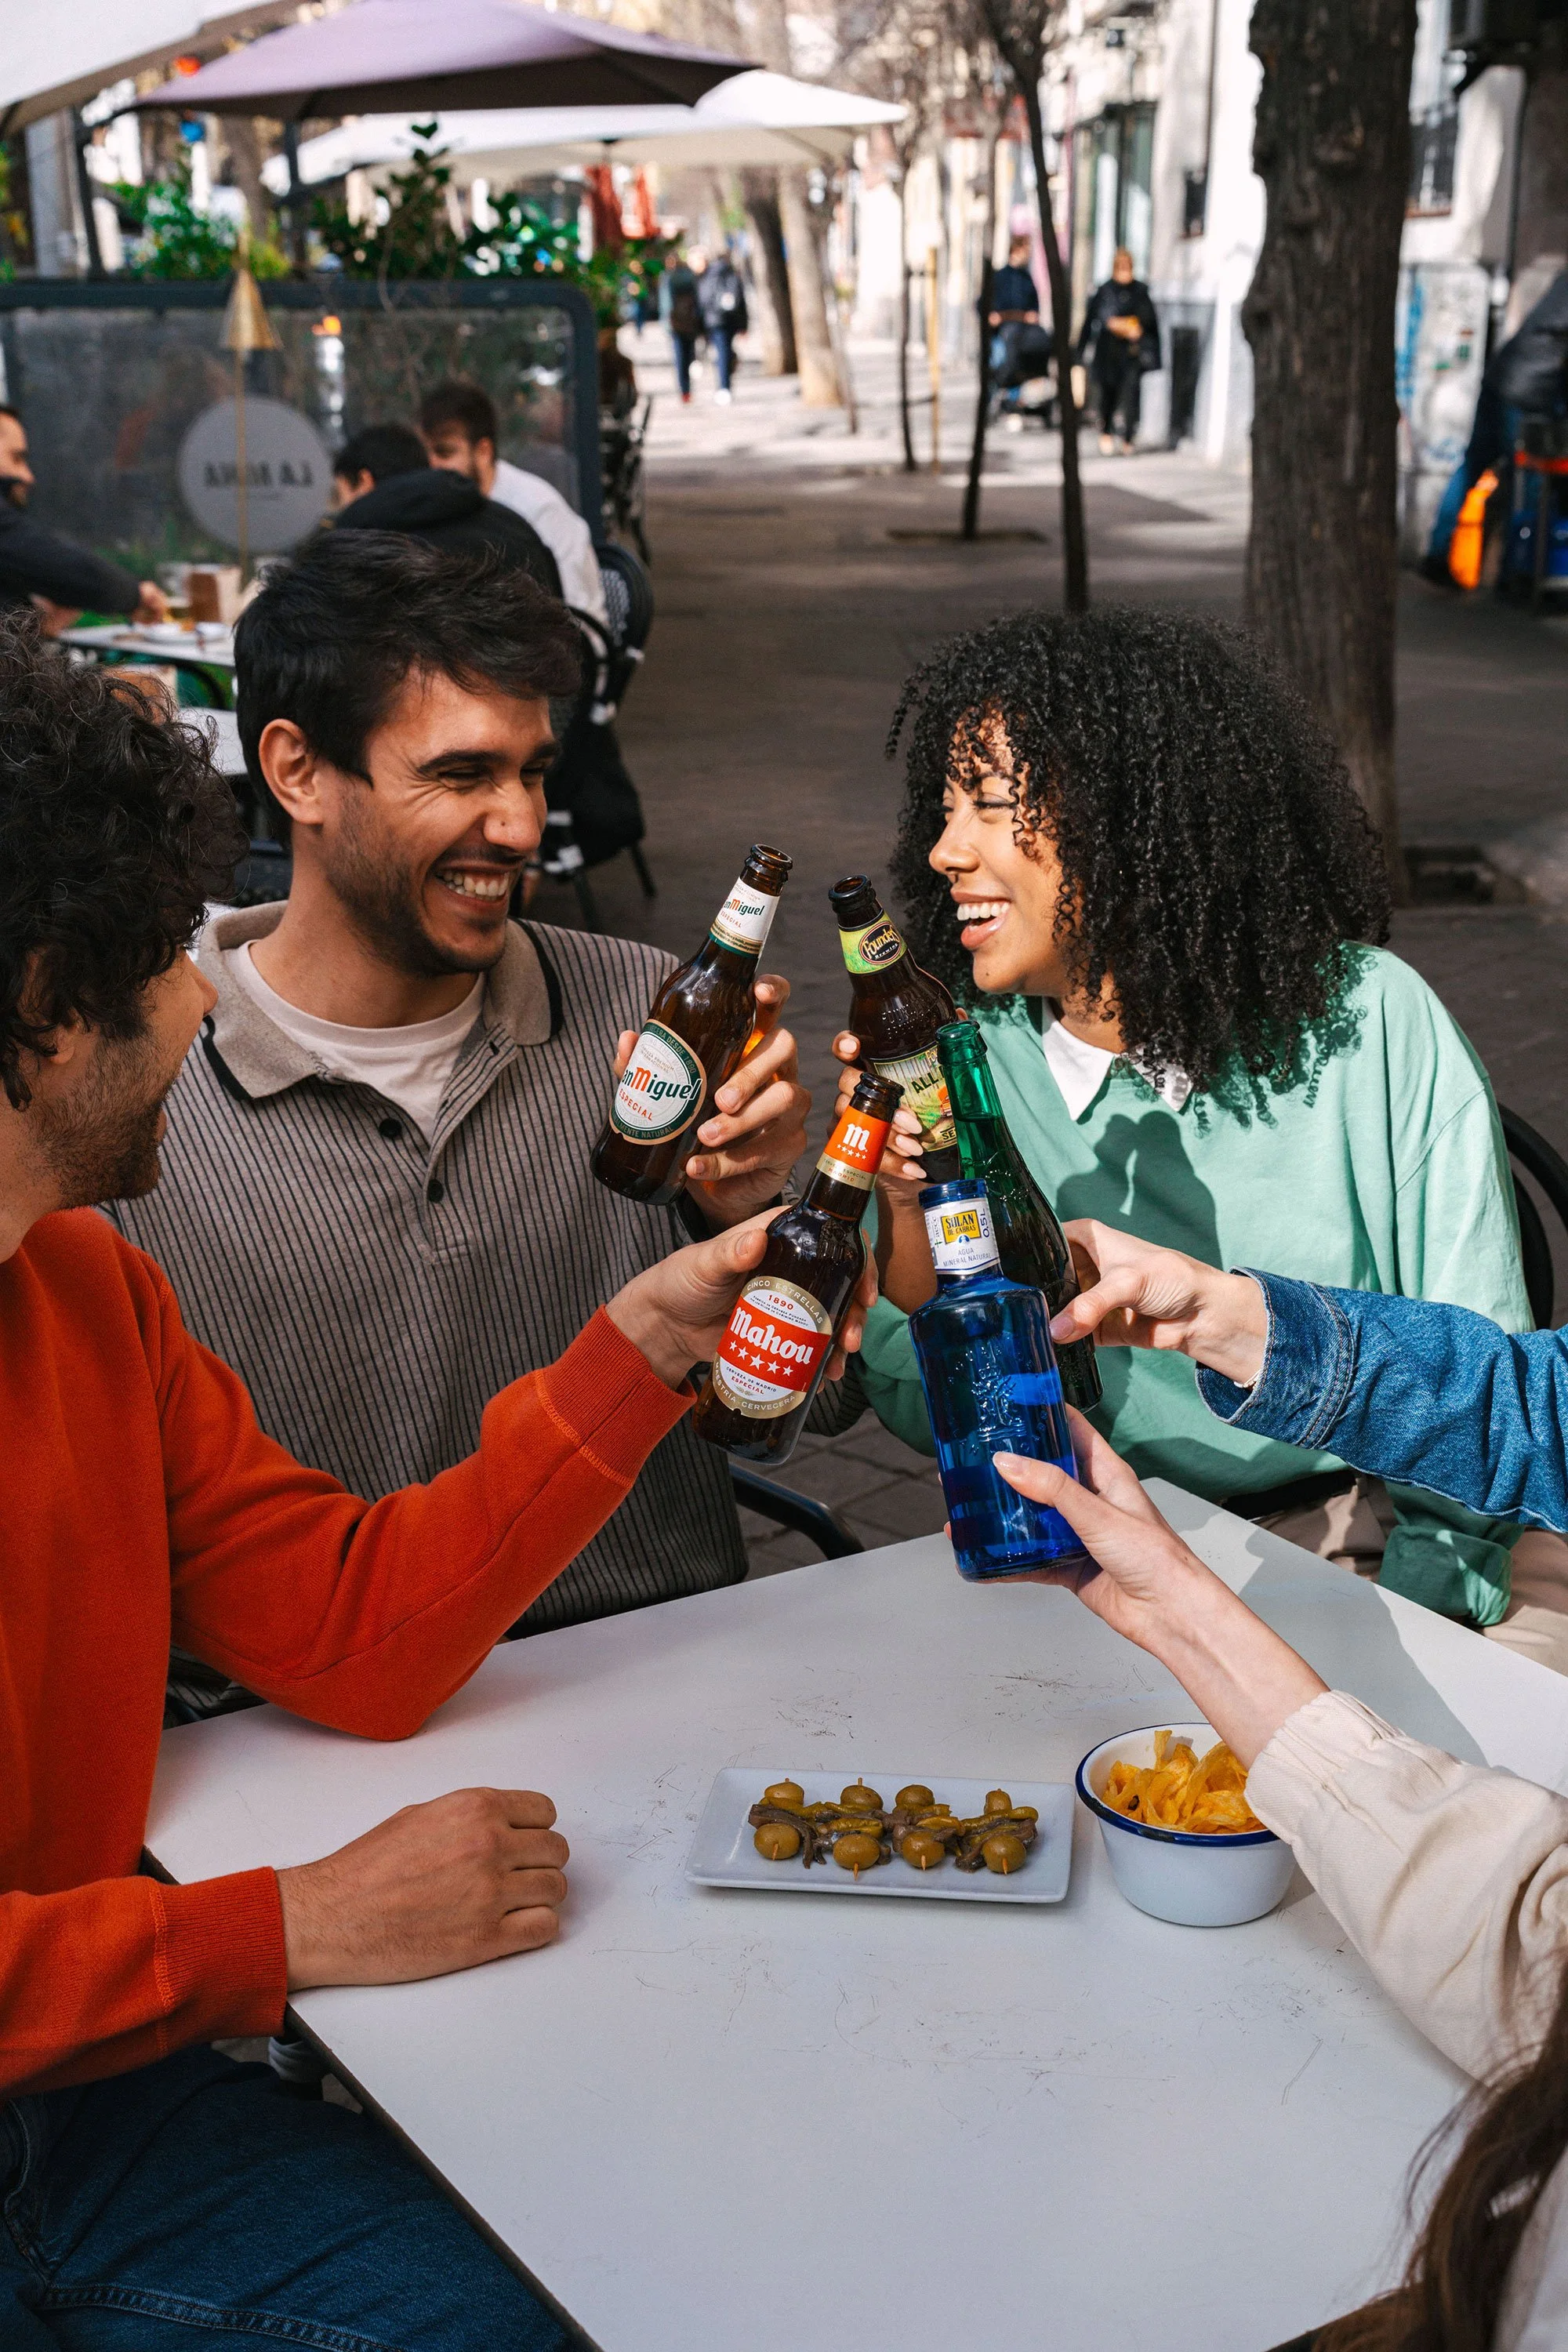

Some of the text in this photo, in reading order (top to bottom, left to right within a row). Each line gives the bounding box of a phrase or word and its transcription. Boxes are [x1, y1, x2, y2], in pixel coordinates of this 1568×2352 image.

[723, 898, 765, 916] anMiguel
[720, 910, 742, 928] ESPECIAL
[874, 942, 898, 960] Brewing
[654, 1056, 674, 1071] PREMIUM
[666, 1035, 686, 1056] DESDE
[683, 1054, 697, 1075] 1890
[621, 1066, 703, 1102] anMiguel
[911, 1072, 939, 1094] ALL
[619, 1088, 653, 1121] ESPECIAL
[641, 1126, 673, 1138] NATURAL
[828, 1167, 855, 1182] MADRID
[955, 1225, 977, 1234] CABRAS
[943, 1252, 992, 1267] MINERAL NATURAL
[957, 1247, 975, 1256] AGUA
[746, 1279, 823, 1323] CINCO ESTRELLAS
[768, 1294, 794, 1311] 1890
[730, 1306, 815, 1365] Mahou
[725, 1366, 746, 1380] CERVEZA
[756, 1380, 778, 1392] MADRID
[731, 1375, 765, 1395] ESPECIAL
[741, 1395, 796, 1410] CERVECERA
